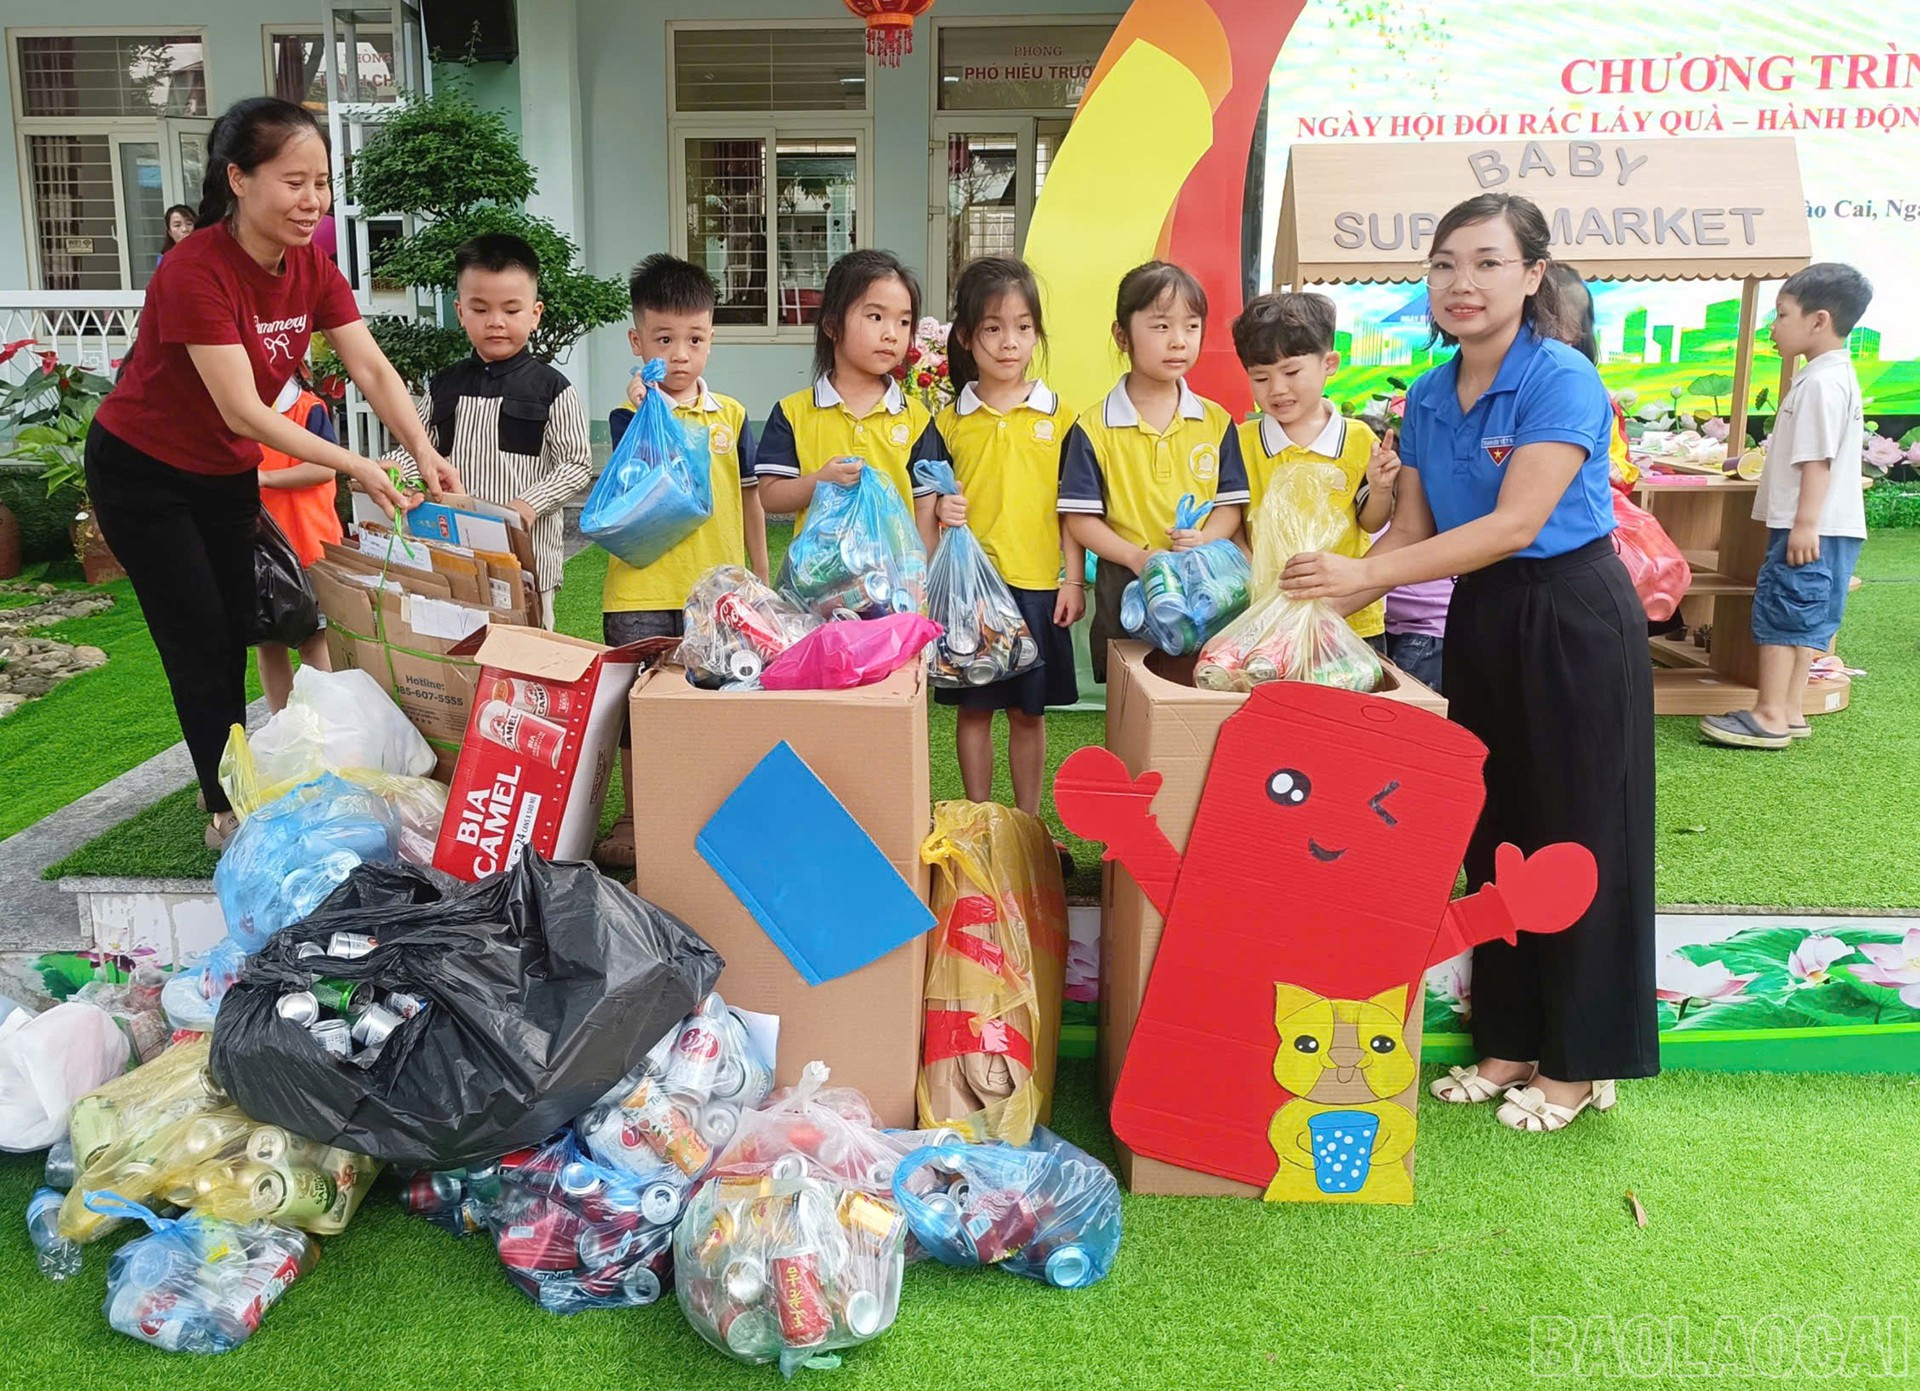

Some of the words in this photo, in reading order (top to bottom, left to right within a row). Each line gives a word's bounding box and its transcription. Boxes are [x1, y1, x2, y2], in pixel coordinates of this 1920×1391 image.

[965, 63, 999, 80] PHÓ
[1005, 63, 1043, 83] HIỆU
[1561, 50, 1795, 95] CHƯƠNG
[1297, 110, 1382, 138] NGÀY
[1390, 112, 1446, 141] HỘI
[1454, 107, 1508, 136] ĐỔI
[1518, 106, 1582, 135] RÁC
[1589, 105, 1652, 133] LẤY
[1659, 104, 1725, 136] QUÀ
[1756, 102, 1847, 131] HÀNH
[1467, 140, 1648, 189] BABY
[1806, 199, 1827, 219] ào
[405, 675, 445, 690] Hotline:
[456, 789, 491, 845] BIA
[473, 765, 522, 879] CAMEL
[515, 833, 526, 846] 24
